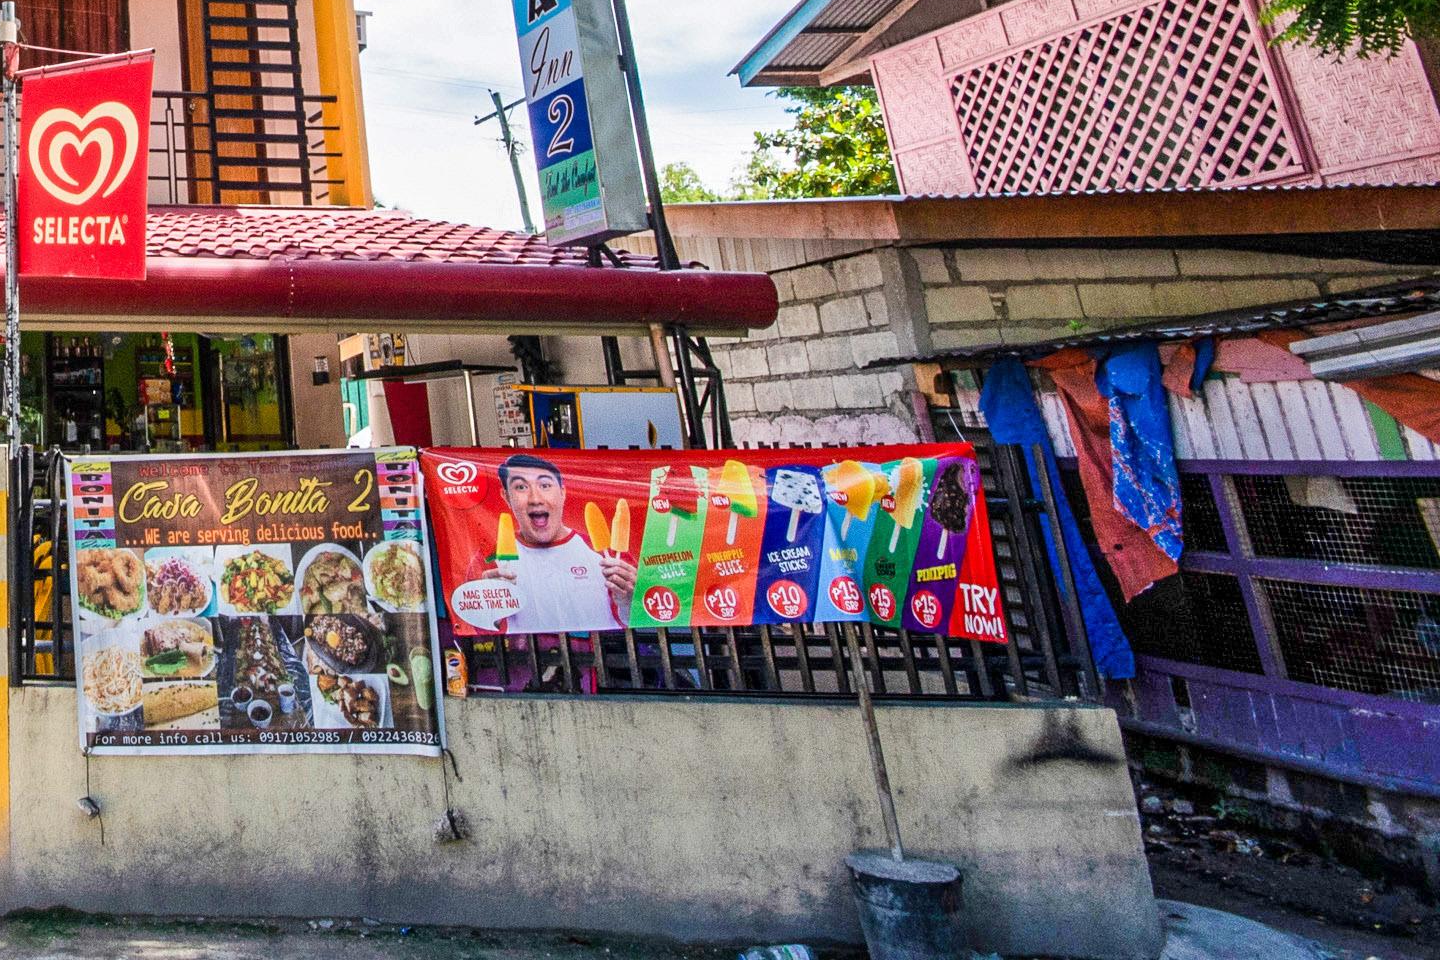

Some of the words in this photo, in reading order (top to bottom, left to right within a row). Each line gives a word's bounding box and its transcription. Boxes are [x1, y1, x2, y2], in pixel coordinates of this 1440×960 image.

[530, 26, 573, 98] Inn
[547, 94, 574, 158] 2
[33, 215, 126, 246] SELECTA
[118, 480, 203, 523] Casa
[220, 476, 333, 525] Bonita
[347, 468, 374, 513] 2
[443, 486, 478, 495] SELECTA
[652, 499, 670, 511] NEW
[711, 495, 729, 506] NEW
[881, 497, 896, 511] NEW
[168, 531, 189, 544] are
[197, 526, 250, 546] serving
[256, 523, 325, 541] delicious
[643, 550, 693, 566] WATERMELON
[706, 548, 744, 563] PINEAPPLE
[767, 552, 781, 563] ICE
[781, 545, 811, 559] CREAM
[658, 562, 687, 580] SLICE
[714, 559, 745, 577] SLICE
[778, 558, 808, 573] STICKS
[916, 563, 956, 582] PINIPIG
[462, 590, 480, 599] MAG
[482, 588, 511, 599] SELECTA
[959, 583, 997, 616] TRY
[458, 600, 483, 611] SNACK
[485, 599, 503, 609] TIME
[964, 614, 1004, 638] NOW!
[95, 733, 116, 744] For
[123, 734, 151, 744] more
[160, 732, 188, 744] info
[195, 732, 223, 744] call
[231, 732, 251, 743] us:
[260, 731, 340, 743] 09171052985
